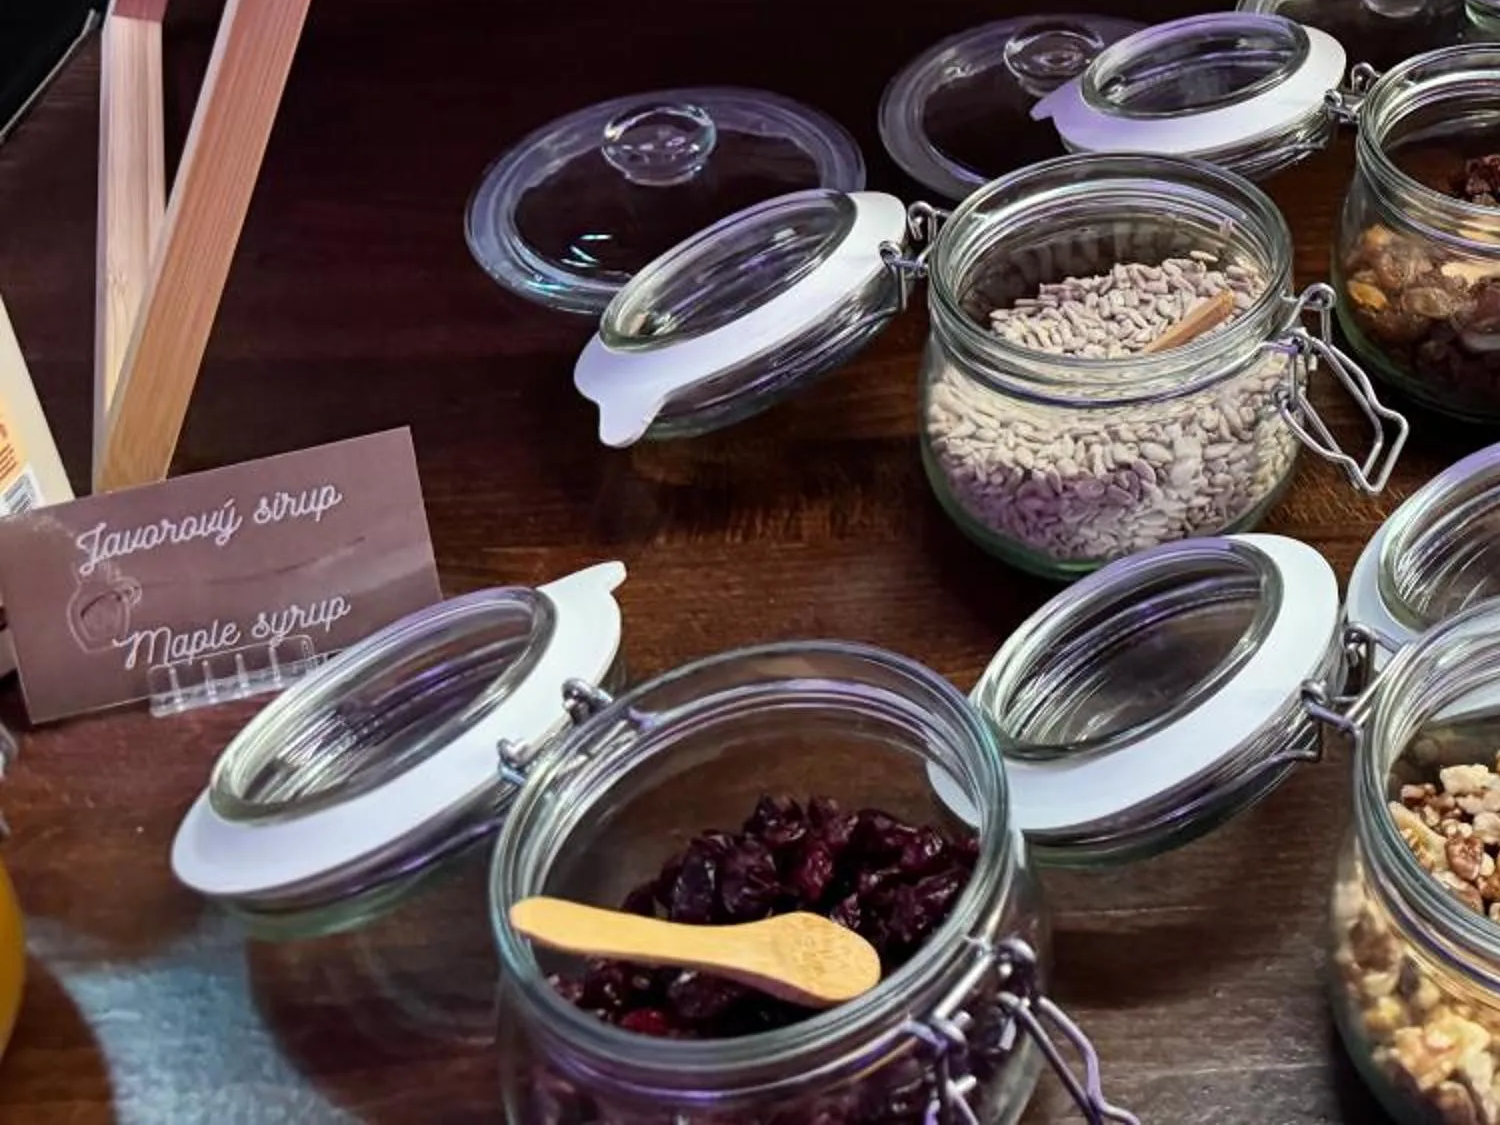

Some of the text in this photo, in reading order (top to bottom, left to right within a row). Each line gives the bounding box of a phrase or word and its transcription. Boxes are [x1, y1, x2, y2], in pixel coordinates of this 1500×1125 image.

[75, 482, 343, 576] Javorový sirup
[111, 594, 351, 669] Maple syrup
